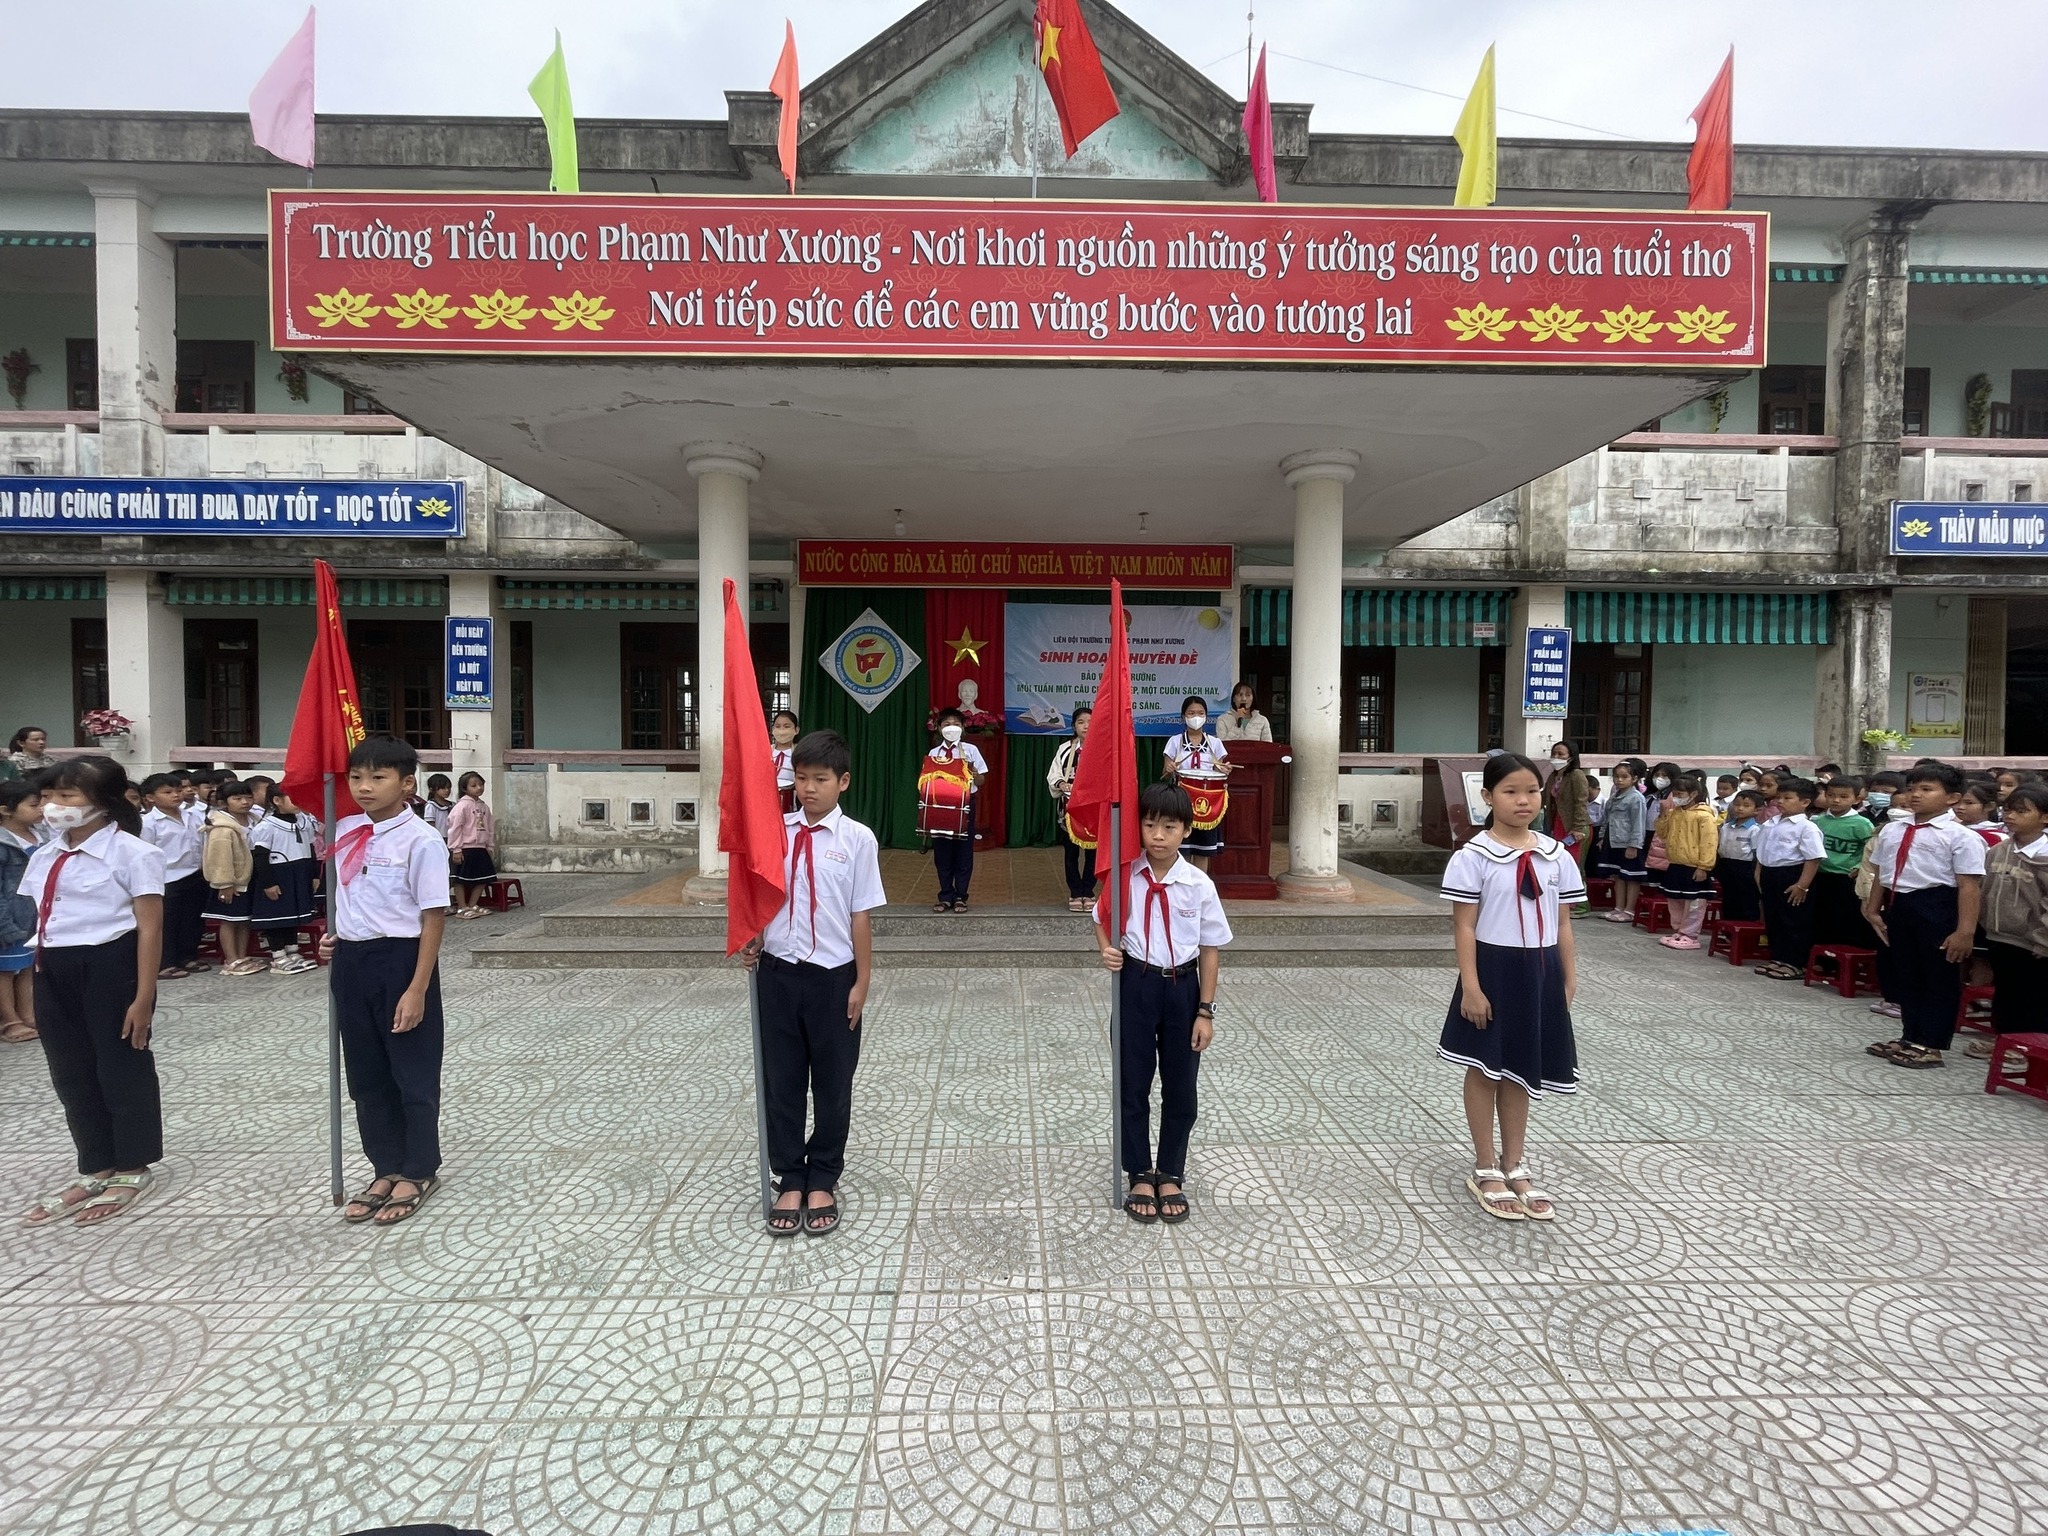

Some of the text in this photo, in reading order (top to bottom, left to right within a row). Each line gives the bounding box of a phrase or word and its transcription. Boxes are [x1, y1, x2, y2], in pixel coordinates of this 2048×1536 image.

[311, 218, 433, 268] Trường
[442, 210, 518, 261] Tiểu
[527, 222, 588, 271] học
[598, 222, 691, 271] Phạm
[700, 224, 769, 264] Như
[777, 228, 882, 274] Xương
[911, 226, 967, 266] Nơi
[976, 227, 1047, 268] khơi
[1056, 220, 1157, 277] nguồn
[1166, 230, 1267, 280] những
[1276, 230, 1296, 280] ý
[1305, 229, 1396, 282] tưởng
[1405, 232, 1480, 283] sáng
[1489, 240, 1538, 284] tạo
[1548, 234, 1603, 277] của
[1612, 228, 1672, 277] tuổi
[1681, 239, 1733, 278] thơ
[648, 278, 1413, 343] Nơi tiếp sức để các em vững bước vào tương lai
[19, 487, 56, 519] ĐÂU
[61, 488, 112, 519] CŨNG
[117, 486, 160, 519] PHẢI
[165, 493, 197, 520] THI
[202, 493, 239, 521] ĐUA
[243, 494, 280, 526] DẠY
[284, 486, 319, 522] TỐT
[336, 494, 374, 527] HỌC
[378, 487, 413, 523] TỐT
[1939, 508, 2046, 550] THẦY MẪU MỰC
[805, 546, 844, 573] NƯỚC
[850, 548, 888, 578] CỘNG
[894, 548, 923, 573] HÒA
[926, 549, 947, 574] XÃ
[951, 548, 976, 579] HỘI
[981, 547, 1012, 575] CHỦ
[1017, 550, 1064, 575] NGHĨA
[1069, 550, 1104, 579] VIỆT
[1110, 555, 1141, 576] NAM
[1145, 552, 1184, 576] MUÔN
[1040, 648, 1198, 667] SINH HOẠ HUYÊN ĐỀ
[1081, 670, 1096, 680] BẢO
[1130, 671, 1157, 681] RƯỜNG
[1074, 684, 1090, 694] CÂU
